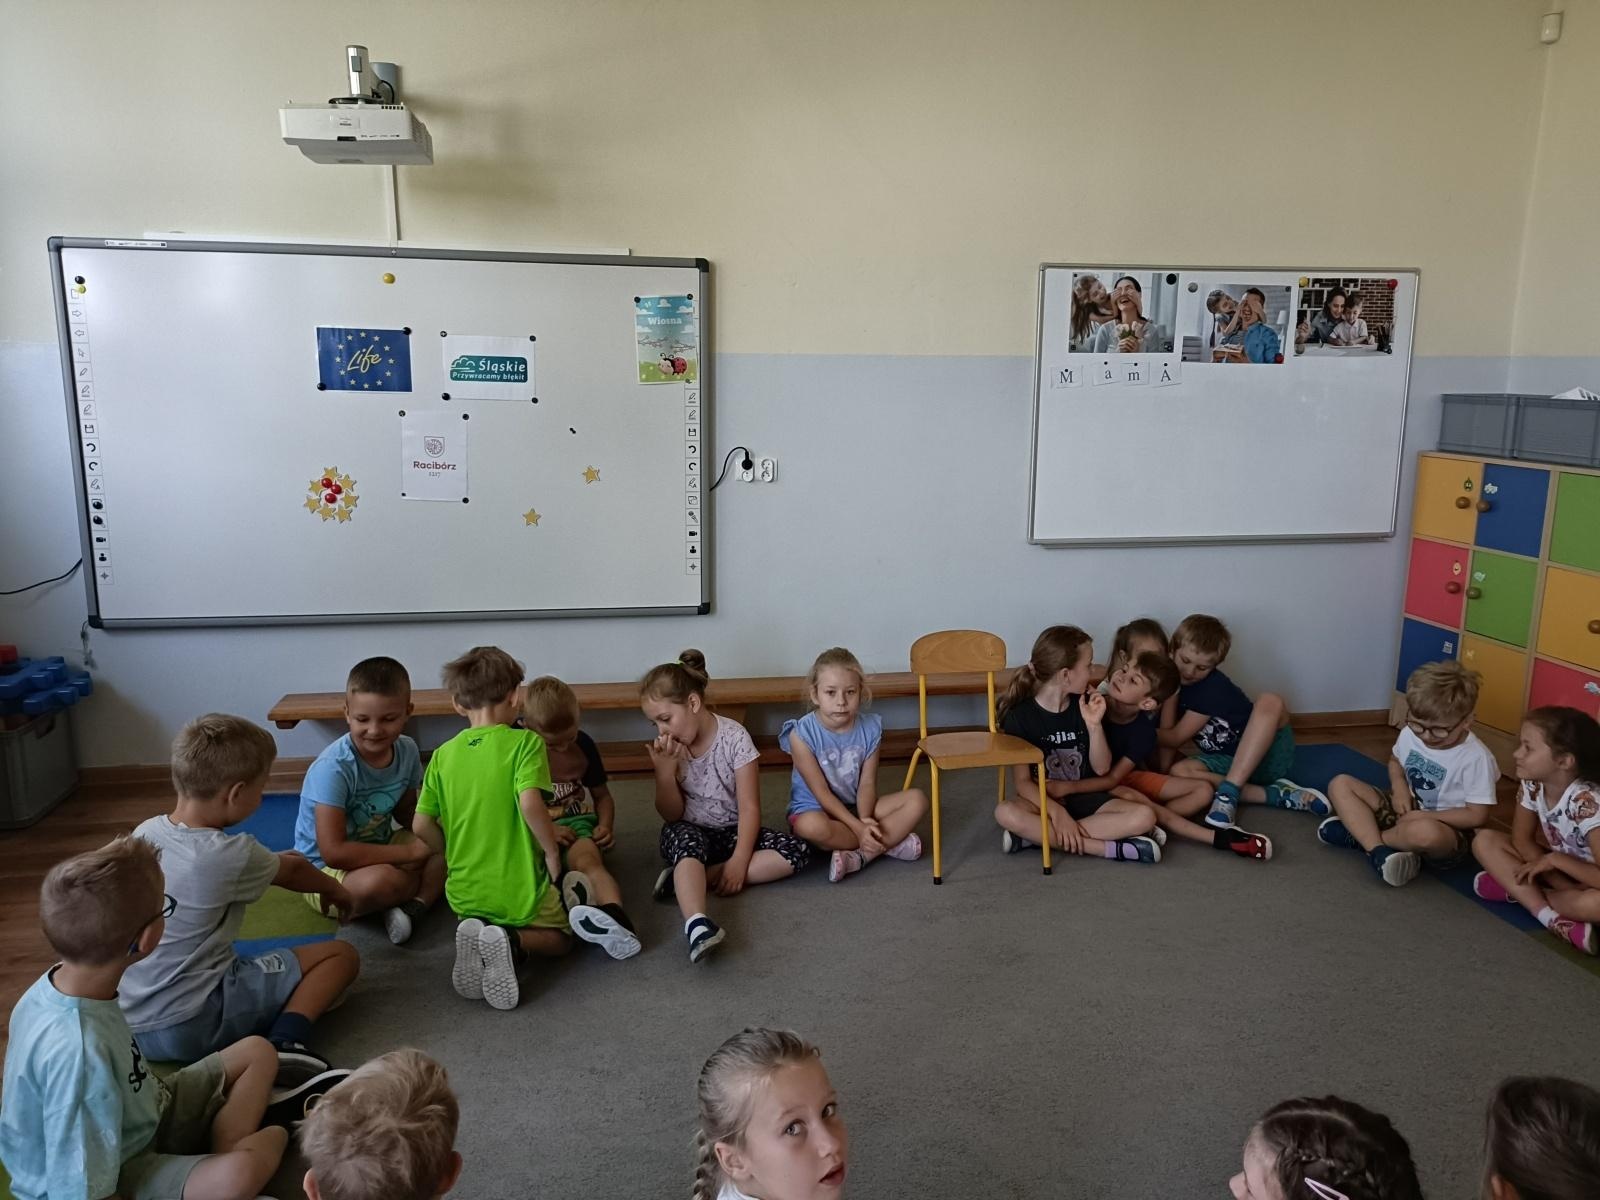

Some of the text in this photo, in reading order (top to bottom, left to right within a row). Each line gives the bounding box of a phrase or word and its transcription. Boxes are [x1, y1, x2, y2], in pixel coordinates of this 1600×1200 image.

[647, 317, 682, 325] Wiosna
[347, 345, 382, 373] Life
[478, 358, 526, 373] Śląskie
[452, 372, 501, 380] Przywracamy
[1060, 371, 1073, 384] M
[413, 461, 457, 471] Racibórz
